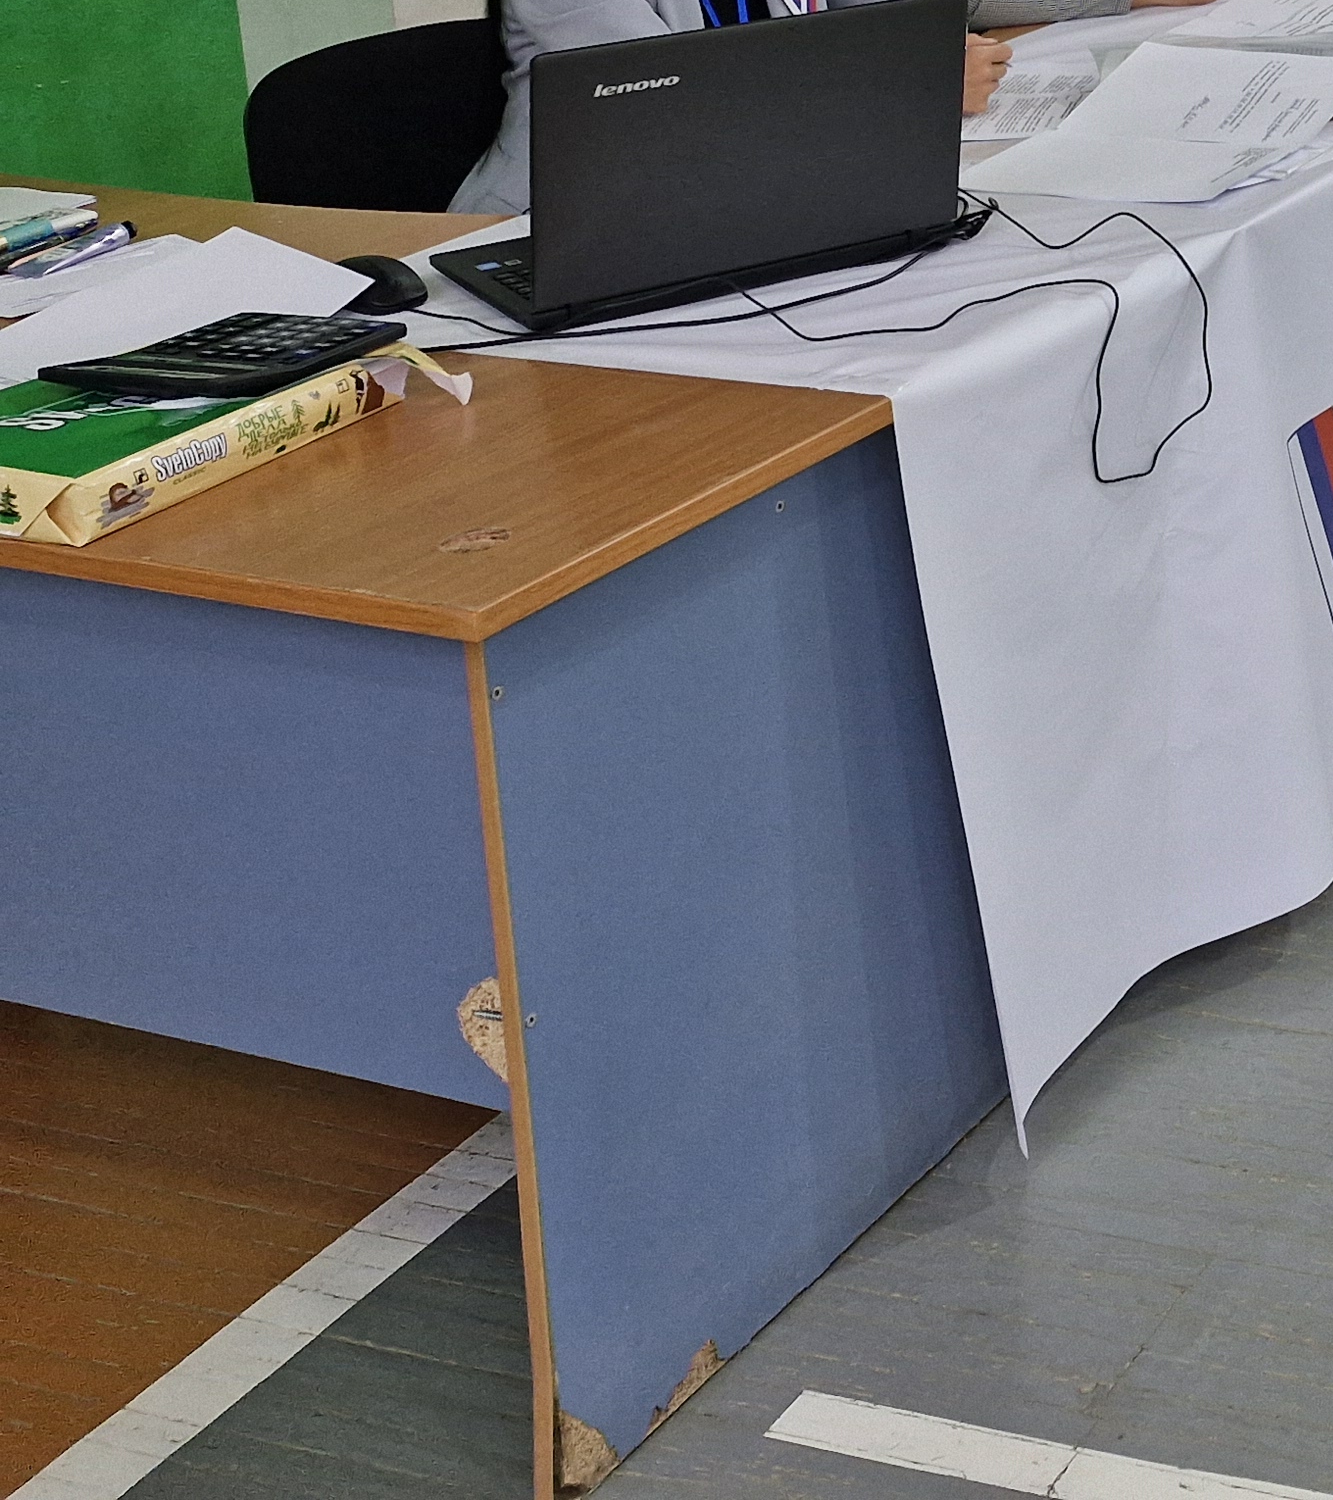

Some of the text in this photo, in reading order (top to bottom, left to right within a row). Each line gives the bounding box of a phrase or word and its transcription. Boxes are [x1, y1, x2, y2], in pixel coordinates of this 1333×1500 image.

[593, 75, 680, 98] lenovo
[235, 405, 286, 442] ДОБРЫЕ
[151, 432, 227, 482] SvetoCopy
